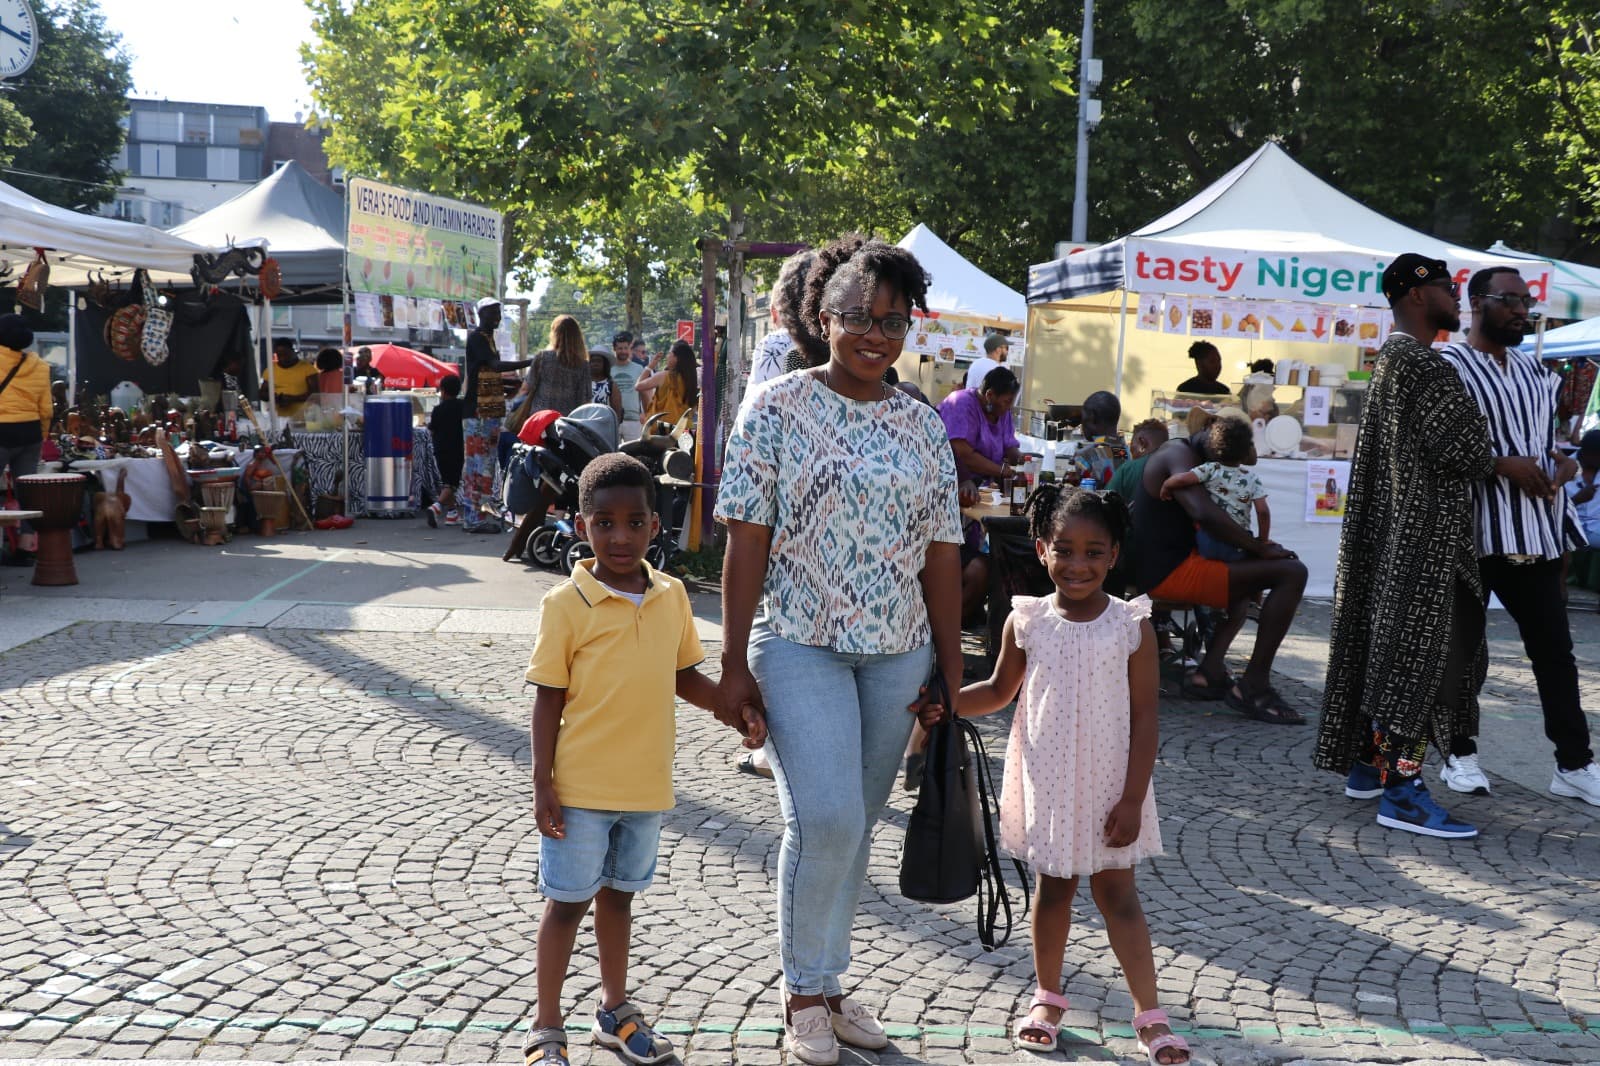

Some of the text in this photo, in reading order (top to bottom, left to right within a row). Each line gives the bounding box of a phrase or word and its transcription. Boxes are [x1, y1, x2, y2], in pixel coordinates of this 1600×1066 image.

[357, 186, 496, 239] VERA'S FOOD AND VITAMIN PARADISE
[1136, 251, 1549, 302] tasty Nigeri fd
